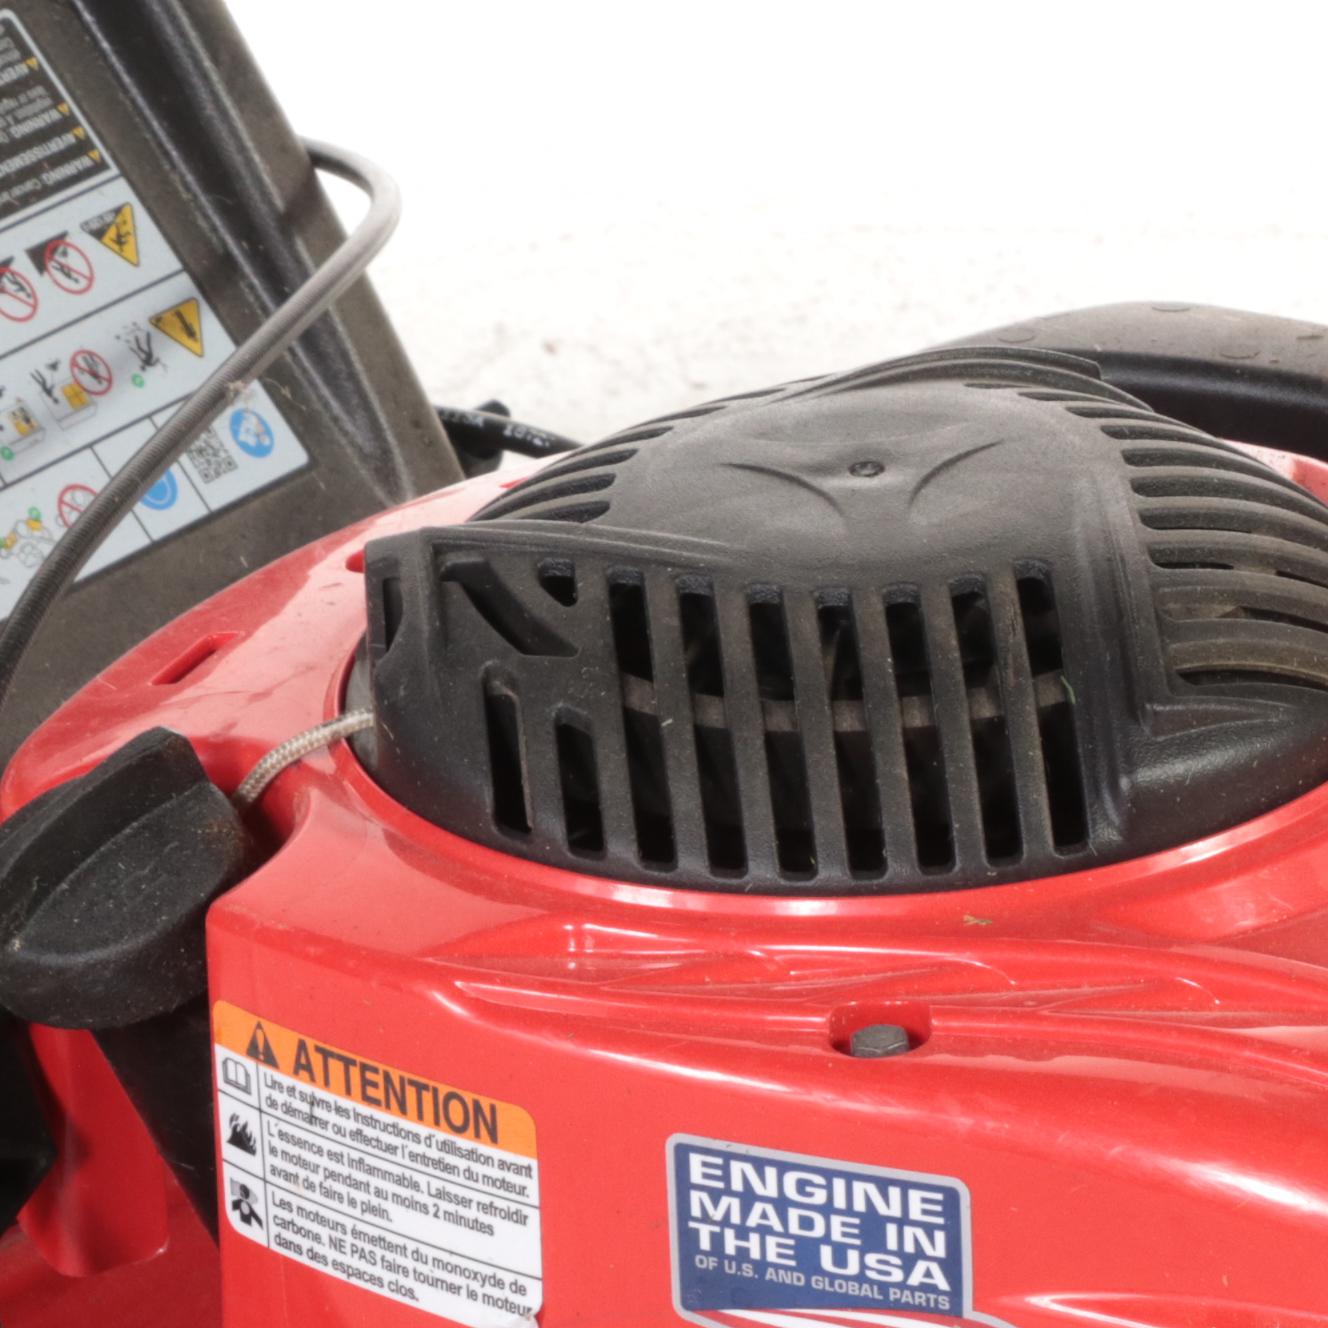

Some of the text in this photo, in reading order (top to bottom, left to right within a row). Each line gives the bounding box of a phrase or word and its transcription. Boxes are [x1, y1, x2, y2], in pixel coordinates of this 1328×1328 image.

[264, 1071, 284, 1094] Lire
[287, 1083, 297, 1098] et
[299, 1089, 333, 1113] suivre
[334, 1105, 351, 1121] les
[353, 1111, 421, 1145] instructions
[497, 1158, 533, 1179] avant
[293, 1038, 499, 1144] ATTENTION
[265, 1094, 279, 1111] de
[281, 1101, 330, 1130] démarrer
[332, 1123, 347, 1138] ou
[349, 1127, 399, 1156] effectuer
[463, 1164, 479, 1182] du
[482, 1174, 530, 1198] moteur.
[326, 1145, 345, 1163] est
[347, 1149, 425, 1194] inflammable.
[427, 1182, 473, 1210] Laisser
[476, 1199, 529, 1226] refroidir
[268, 1142, 495, 1237] le moteur pendant au moins 2 minutes
[270, 1163, 393, 1224] avant de faire le plein.
[688, 1151, 946, 1225] ENGINE
[689, 1190, 947, 1259] MADE IN
[272, 1190, 527, 1297] Les moteurs émettent du monoxyde de
[273, 1212, 325, 1246] carbone.
[328, 1236, 347, 1254] NE
[350, 1244, 377, 1267] PAS
[380, 1254, 410, 1279] faire
[412, 1268, 463, 1297] tourner
[466, 1284, 479, 1302] le
[274, 1232, 420, 1302] dans des espaces clos.
[688, 1221, 951, 1292] THE USA
[694, 1255, 951, 1310] OF U.S. AND GLOBAL PARTS
